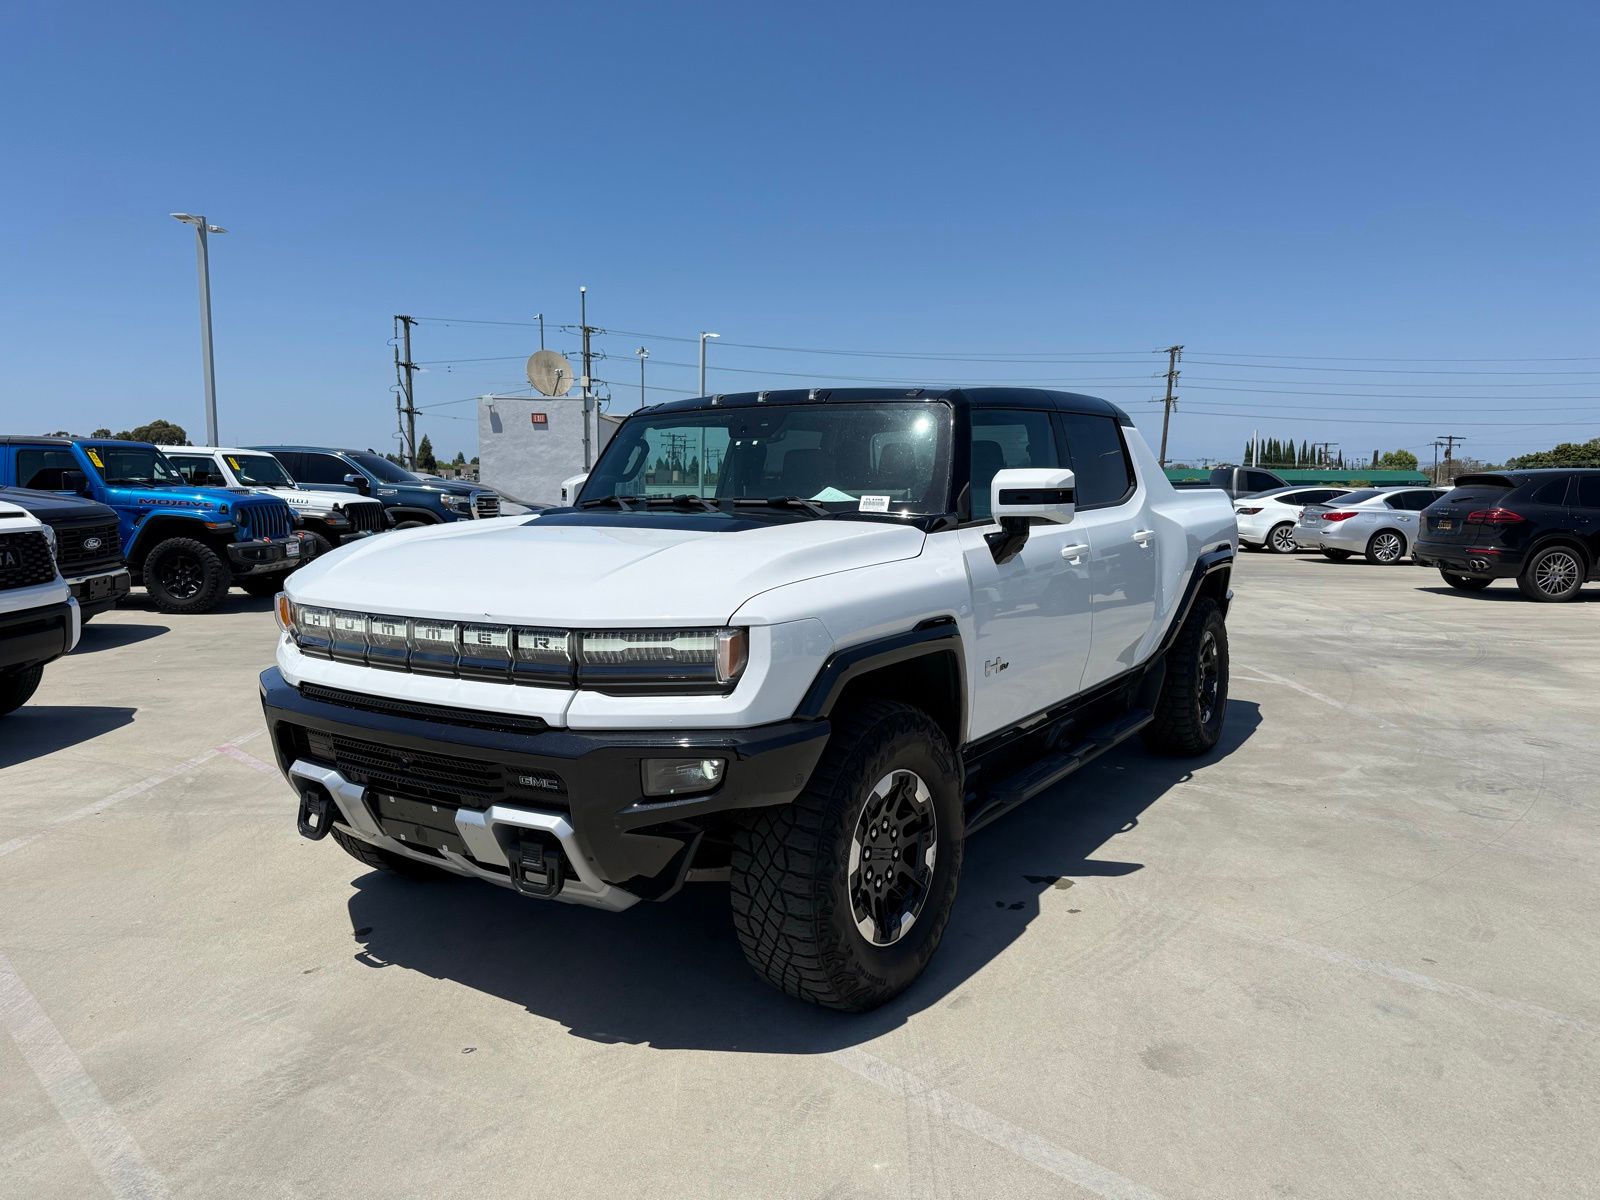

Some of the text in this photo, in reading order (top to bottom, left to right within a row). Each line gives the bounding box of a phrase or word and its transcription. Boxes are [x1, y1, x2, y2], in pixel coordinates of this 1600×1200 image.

[138, 498, 214, 508] MOJAVE
[86, 538, 100, 548] Ford
[312, 614, 550, 649] HUMMER
[518, 775, 558, 790] GMC
